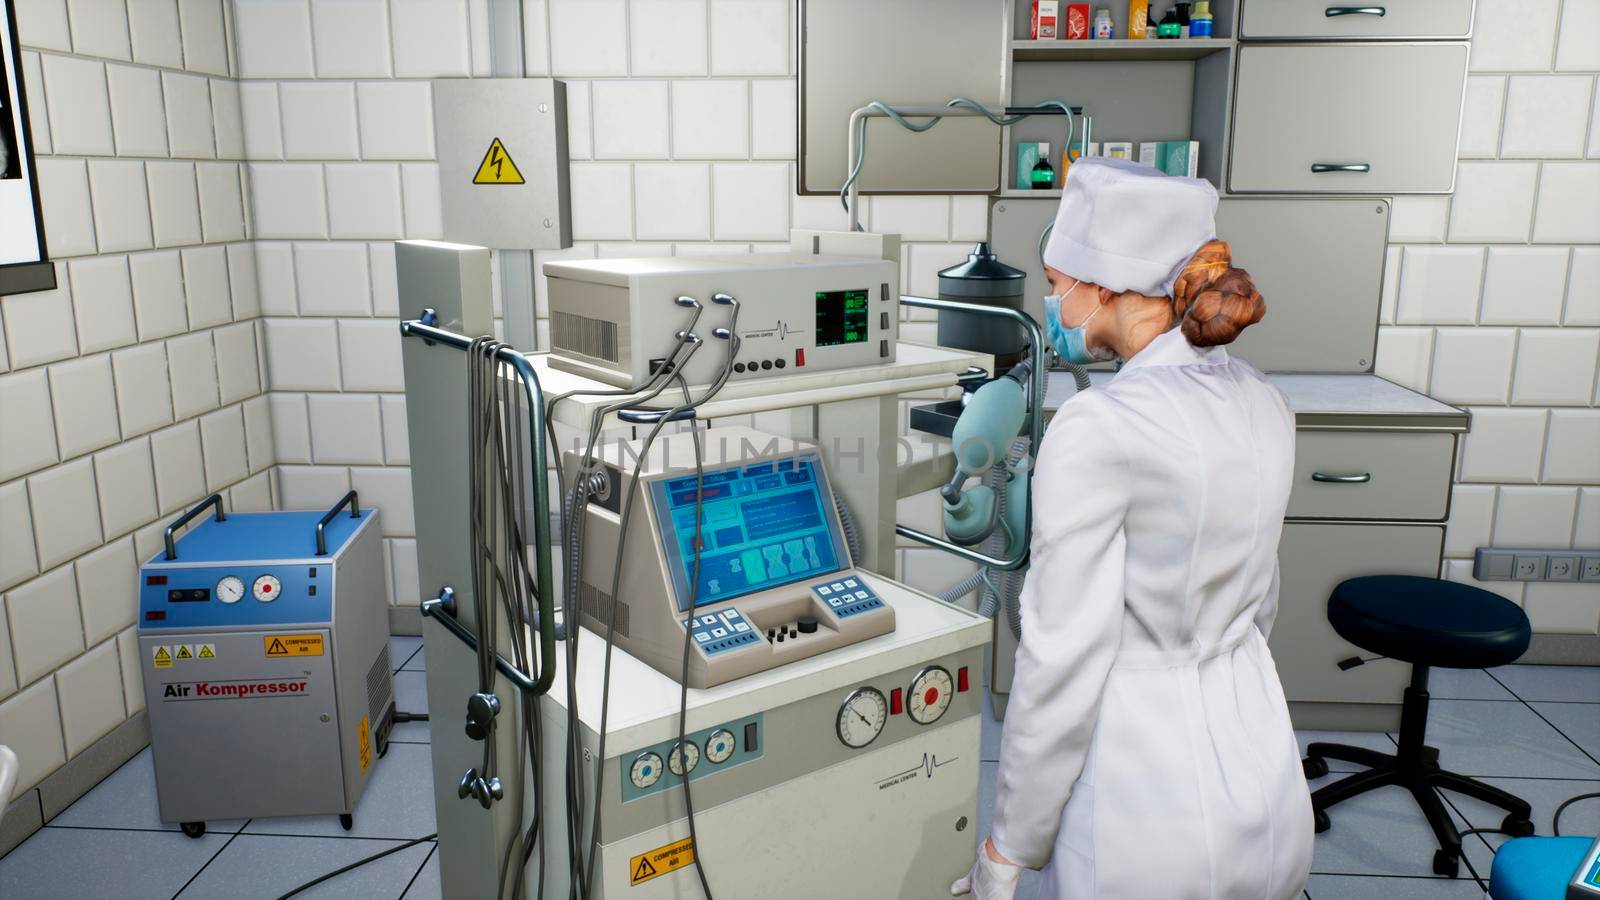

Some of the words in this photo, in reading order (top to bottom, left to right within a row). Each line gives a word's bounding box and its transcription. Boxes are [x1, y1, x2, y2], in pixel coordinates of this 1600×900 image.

[164, 684, 191, 698] Air
[196, 681, 307, 699] Kompressor
[879, 778, 899, 791] MEDICAL
[900, 771, 917, 784] CENTER
[669, 857, 680, 866] AIR
